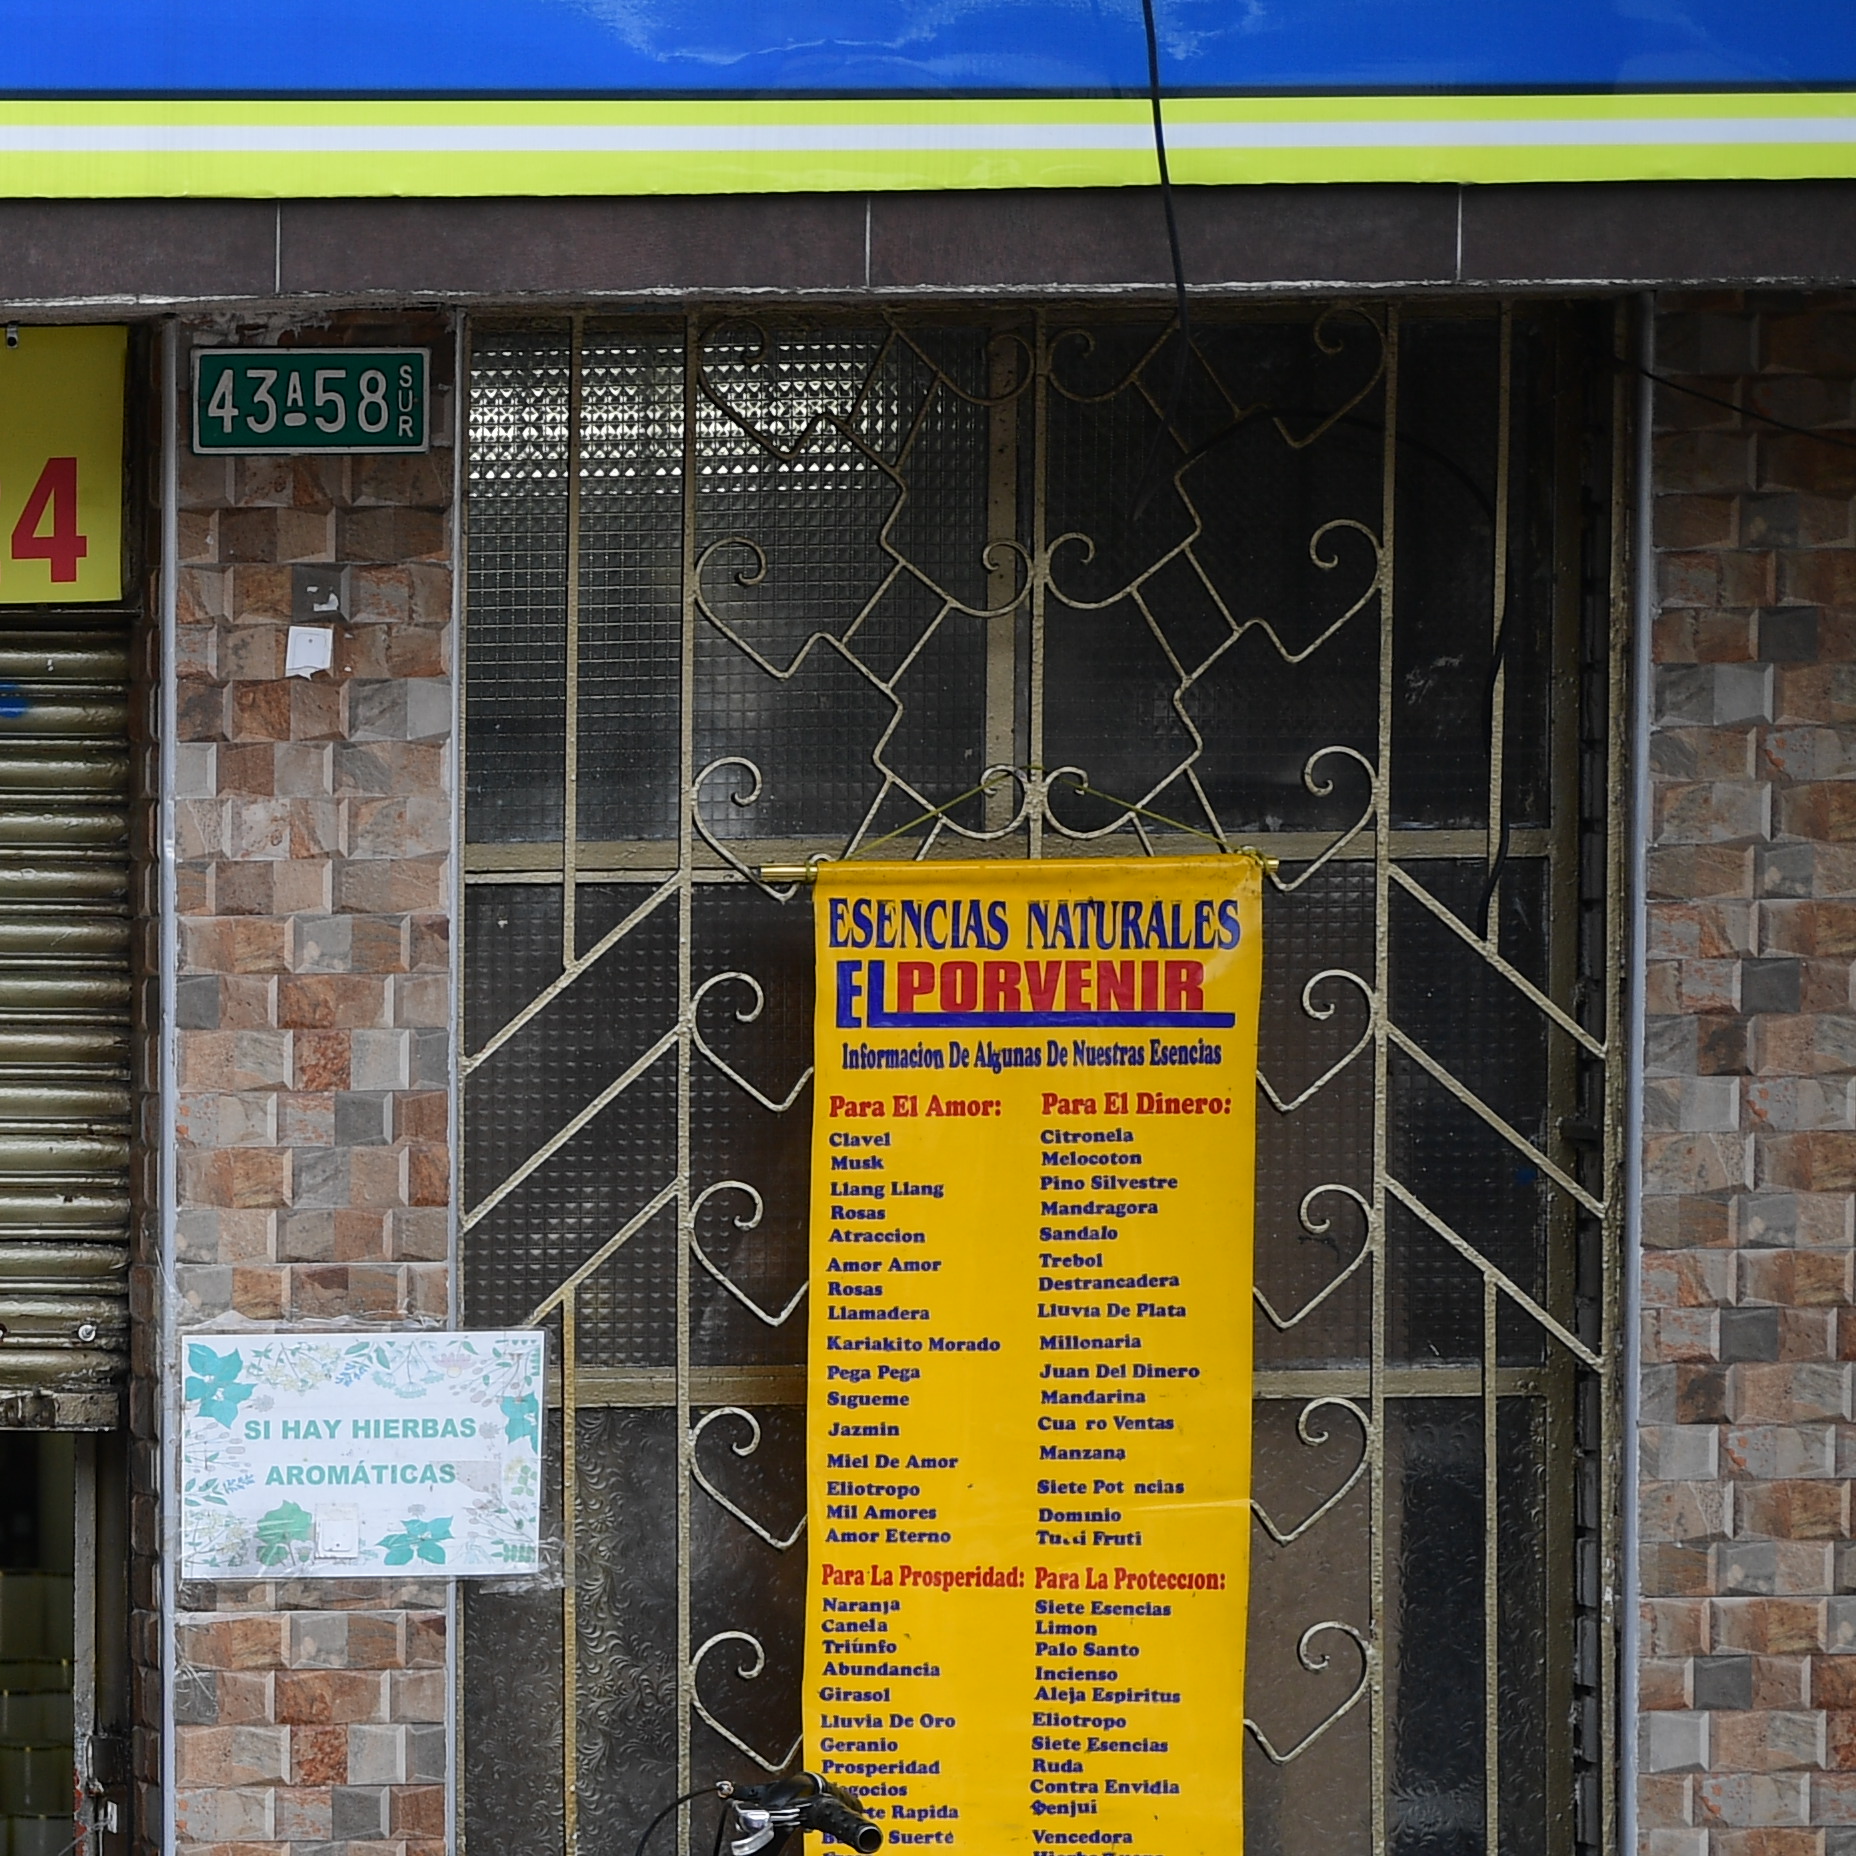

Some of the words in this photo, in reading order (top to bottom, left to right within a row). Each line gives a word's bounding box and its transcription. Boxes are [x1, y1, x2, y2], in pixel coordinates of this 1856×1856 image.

[398, 365, 414, 437] SUR
[828, 897, 1009, 951] ESENCIAS
[1026, 895, 1241, 951] NATURALES
[836, 960, 884, 1028] EL
[897, 961, 1206, 1011] PORVENIR
[842, 1041, 945, 1070] Informacion
[948, 1041, 970, 1069] De
[973, 1040, 1042, 1075] Algunas
[1046, 1039, 1068, 1068] De
[1072, 1039, 1145, 1067] Nuestras
[1149, 1037, 1222, 1066] Esencias
[829, 1095, 886, 1118] Para
[892, 1094, 919, 1118] El
[925, 1094, 1002, 1117] Amor:
[1041, 1092, 1098, 1116] Para
[1103, 1091, 1129, 1115] El
[1135, 1091, 1232, 1115] Dinero:
[828, 1131, 891, 1148] Clavel
[1040, 1127, 1134, 1145] Citronela
[831, 1154, 884, 1171] Musk
[1041, 1150, 1143, 1166] Melocoton
[1040, 1200, 1159, 1218] Mandragora
[825, 1257, 883, 1273] Amor
[887, 1257, 942, 1272] Amor
[827, 1305, 930, 1321] Llamadera
[1039, 1363, 1090, 1379] Juan
[1095, 1363, 1126, 1379] Del
[1132, 1363, 1201, 1379] Dinero
[244, 1420, 271, 1441] SI
[282, 1419, 341, 1439] HAY
[352, 1418, 476, 1439] HIERBAS
[826, 1453, 869, 1469] Miel
[874, 1454, 900, 1469] De
[904, 1454, 959, 1469] Amor
[265, 1460, 456, 1486] AROMÁTICAS
[821, 1563, 865, 1586] Para
[870, 1564, 894, 1587] La
[899, 1564, 1025, 1593] Prosperidad:
[1034, 1566, 1080, 1590] Para
[1085, 1566, 1109, 1590] La
[1114, 1567, 1226, 1591] Proteccion:
[822, 1661, 941, 1677] Abundancia
[1033, 1685, 1086, 1705] Aleja
[1091, 1687, 1181, 1704] Espiritus
[1032, 1829, 1133, 1845] Vencedora
